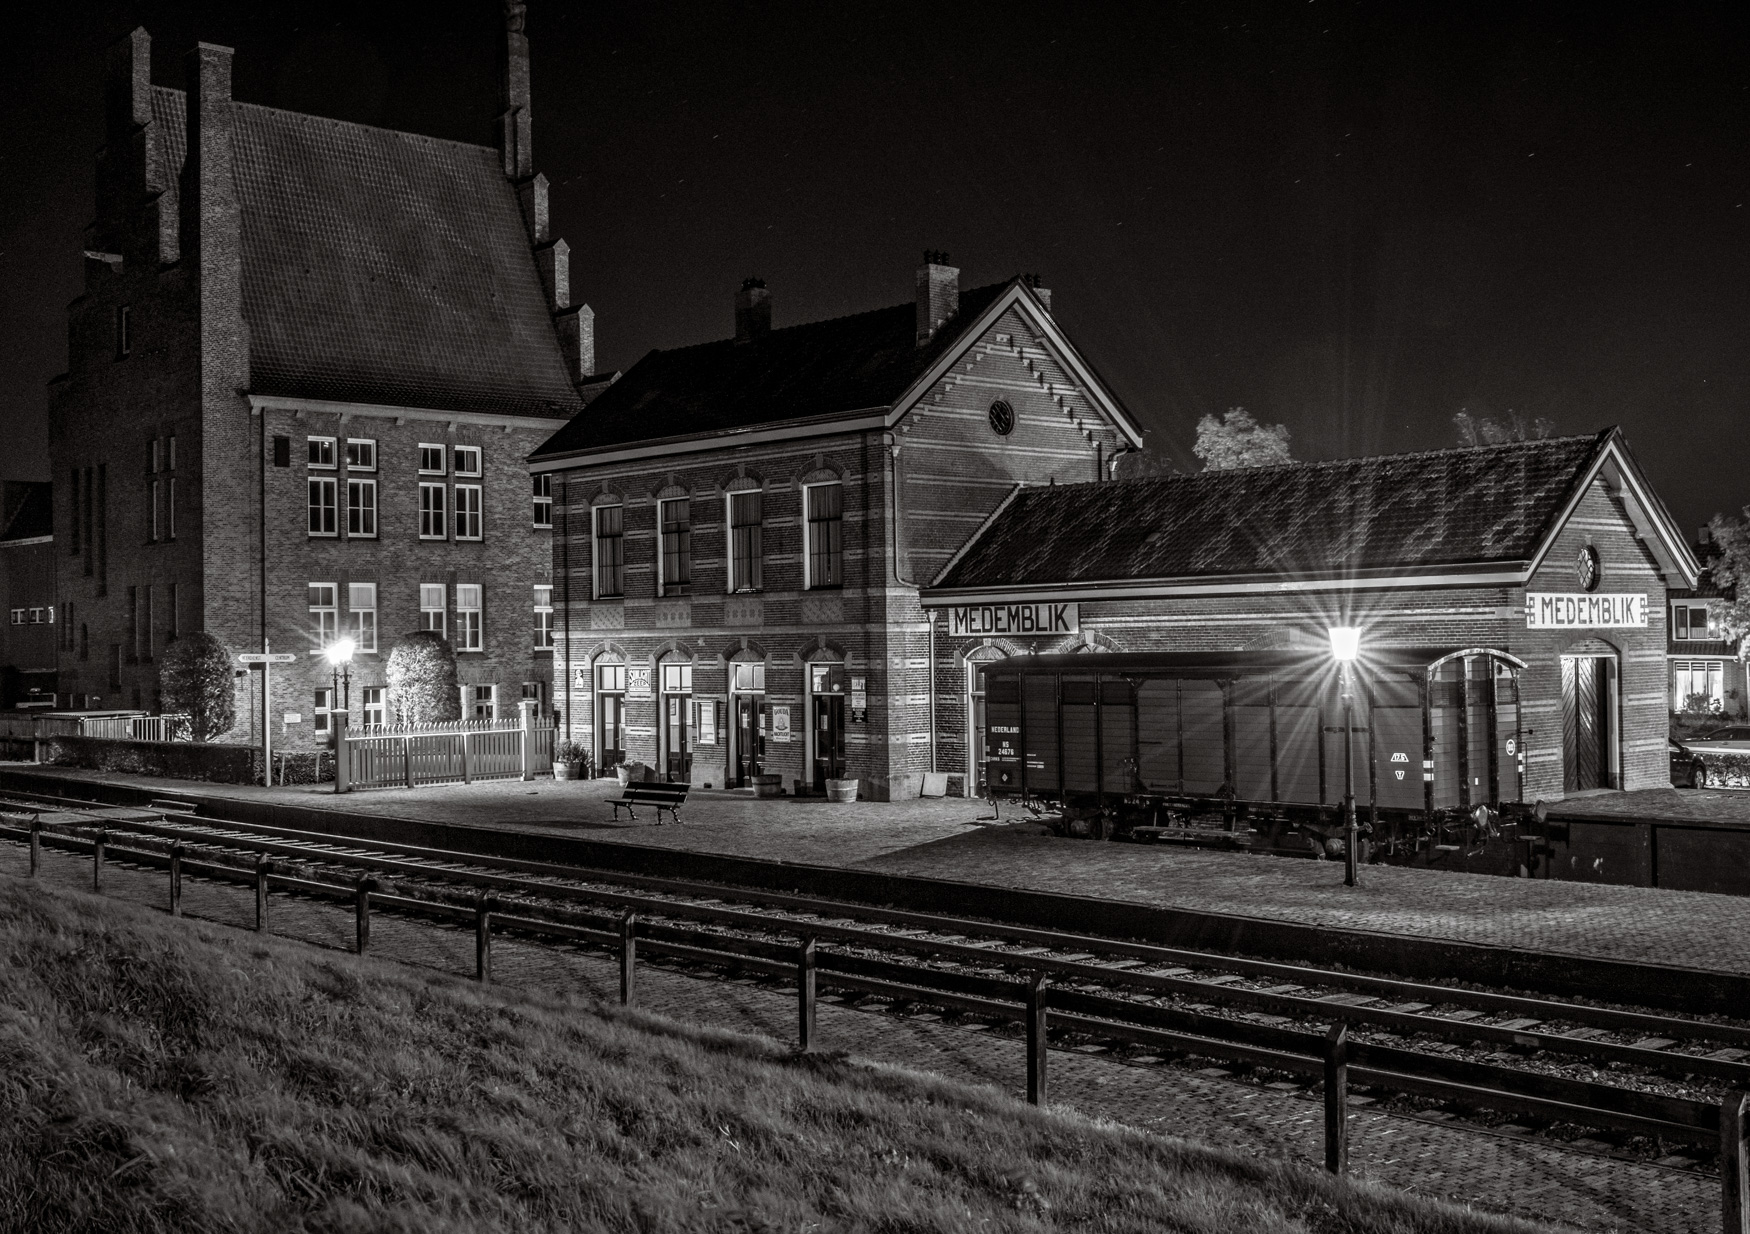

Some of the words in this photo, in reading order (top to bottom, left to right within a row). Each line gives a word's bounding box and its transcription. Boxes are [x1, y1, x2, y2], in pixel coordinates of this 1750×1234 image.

[955, 604, 1070, 634] MEDEMBLIK
[1541, 597, 1635, 625] MEDEMBLIK
[991, 726, 1020, 734] NEDERLAND
